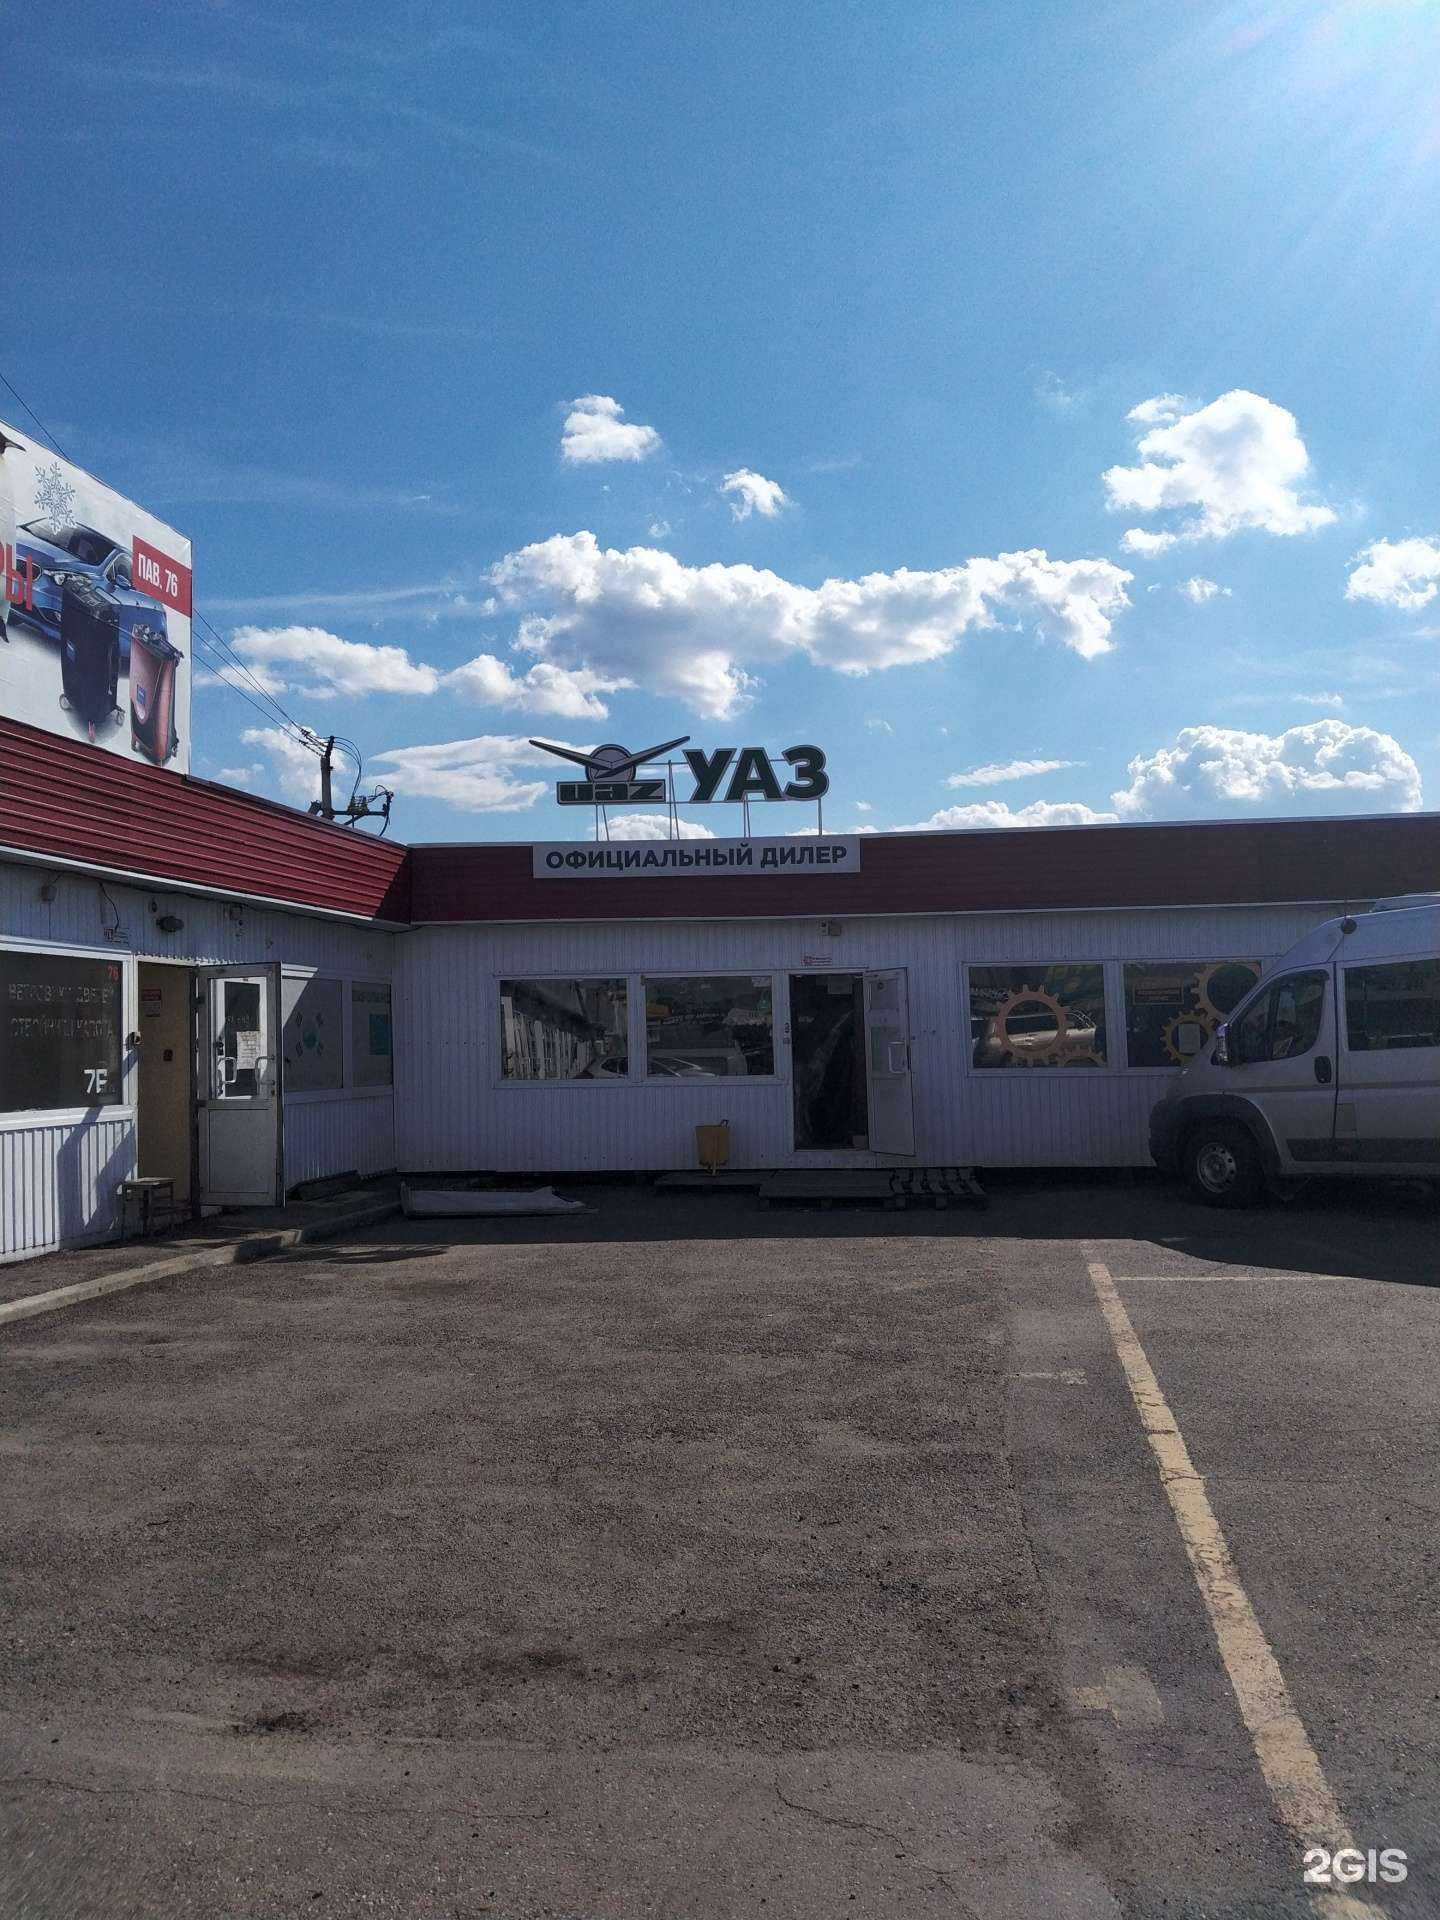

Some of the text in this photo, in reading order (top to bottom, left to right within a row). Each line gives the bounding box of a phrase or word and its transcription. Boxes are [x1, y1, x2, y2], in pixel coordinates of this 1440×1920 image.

[0, 543, 32, 613] Ы
[138, 552, 178, 598] ПАВ. 76
[682, 744, 830, 804] УАЗ
[545, 843, 848, 872] ОФИЦИАЛЬНЫЙ ДИЛЕР
